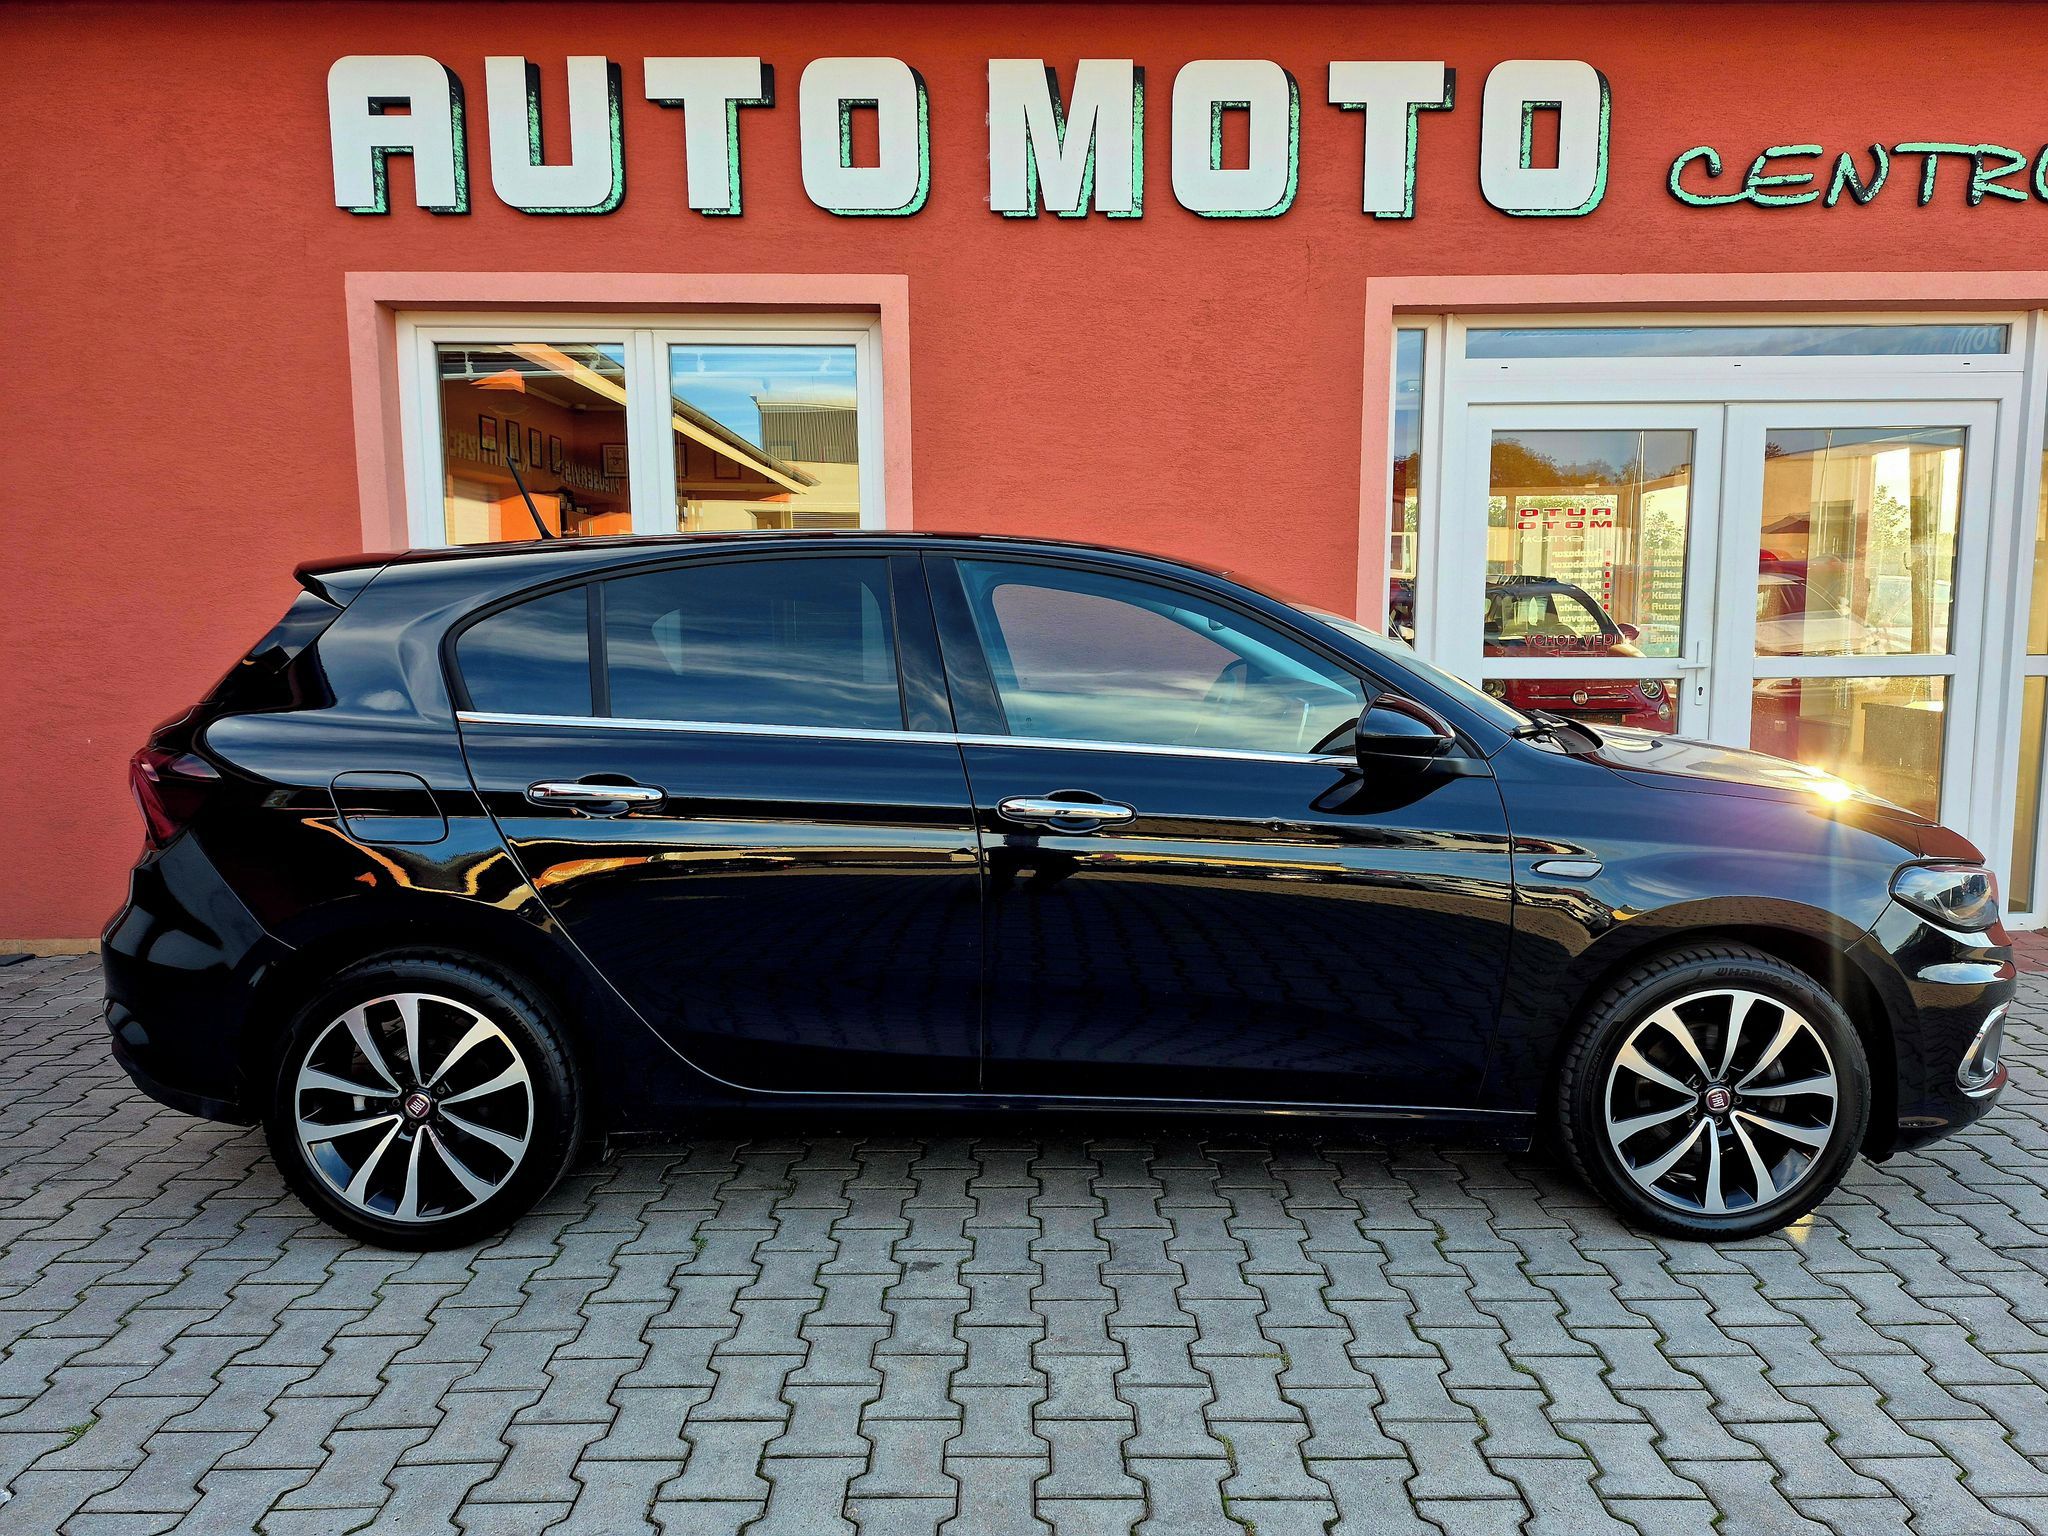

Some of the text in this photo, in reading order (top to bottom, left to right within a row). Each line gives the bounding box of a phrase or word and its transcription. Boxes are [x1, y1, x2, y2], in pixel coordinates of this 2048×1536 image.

[327, 54, 931, 217] AUTO
[987, 57, 1611, 220] MOTO
[1525, 634, 1578, 646] VCHOD
